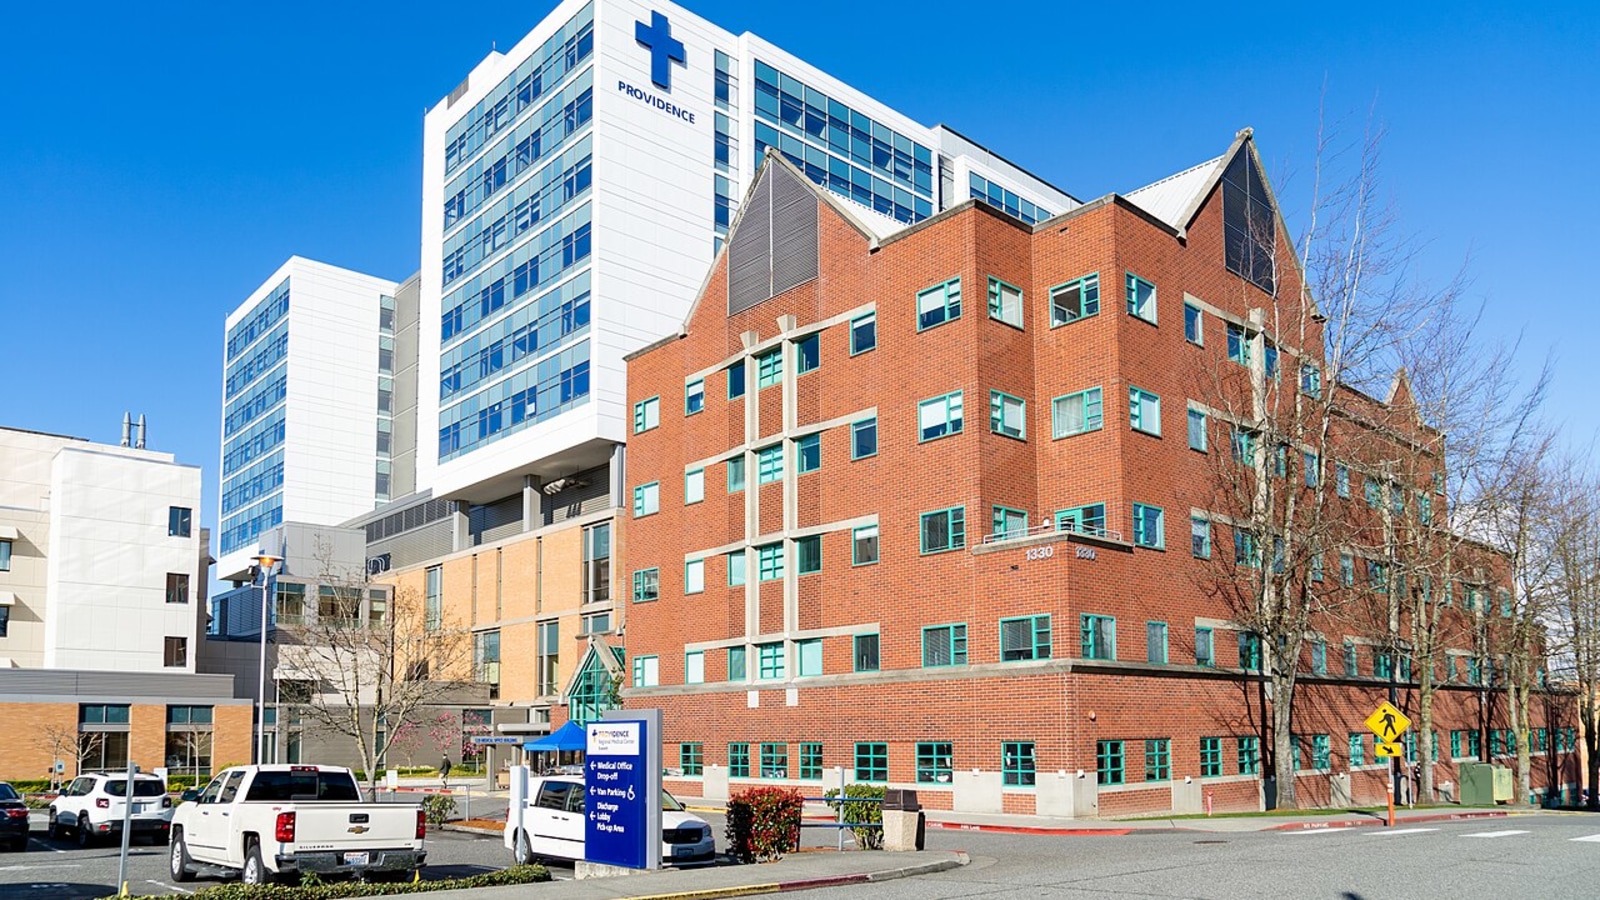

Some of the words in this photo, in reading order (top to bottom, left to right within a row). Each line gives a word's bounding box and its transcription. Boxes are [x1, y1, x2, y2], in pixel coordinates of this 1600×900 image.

[618, 80, 695, 124] PROVIDENCE
[1025, 545, 1054, 561] 1330
[597, 761, 616, 770] Medical
[617, 761, 633, 770] Office
[597, 772, 618, 781] Drop-off
[607, 788, 626, 798] Parking
[597, 802, 619, 812] Discharge
[597, 812, 611, 823] Lobby
[597, 822, 613, 833] Pick-up
[613, 824, 625, 833] Area
